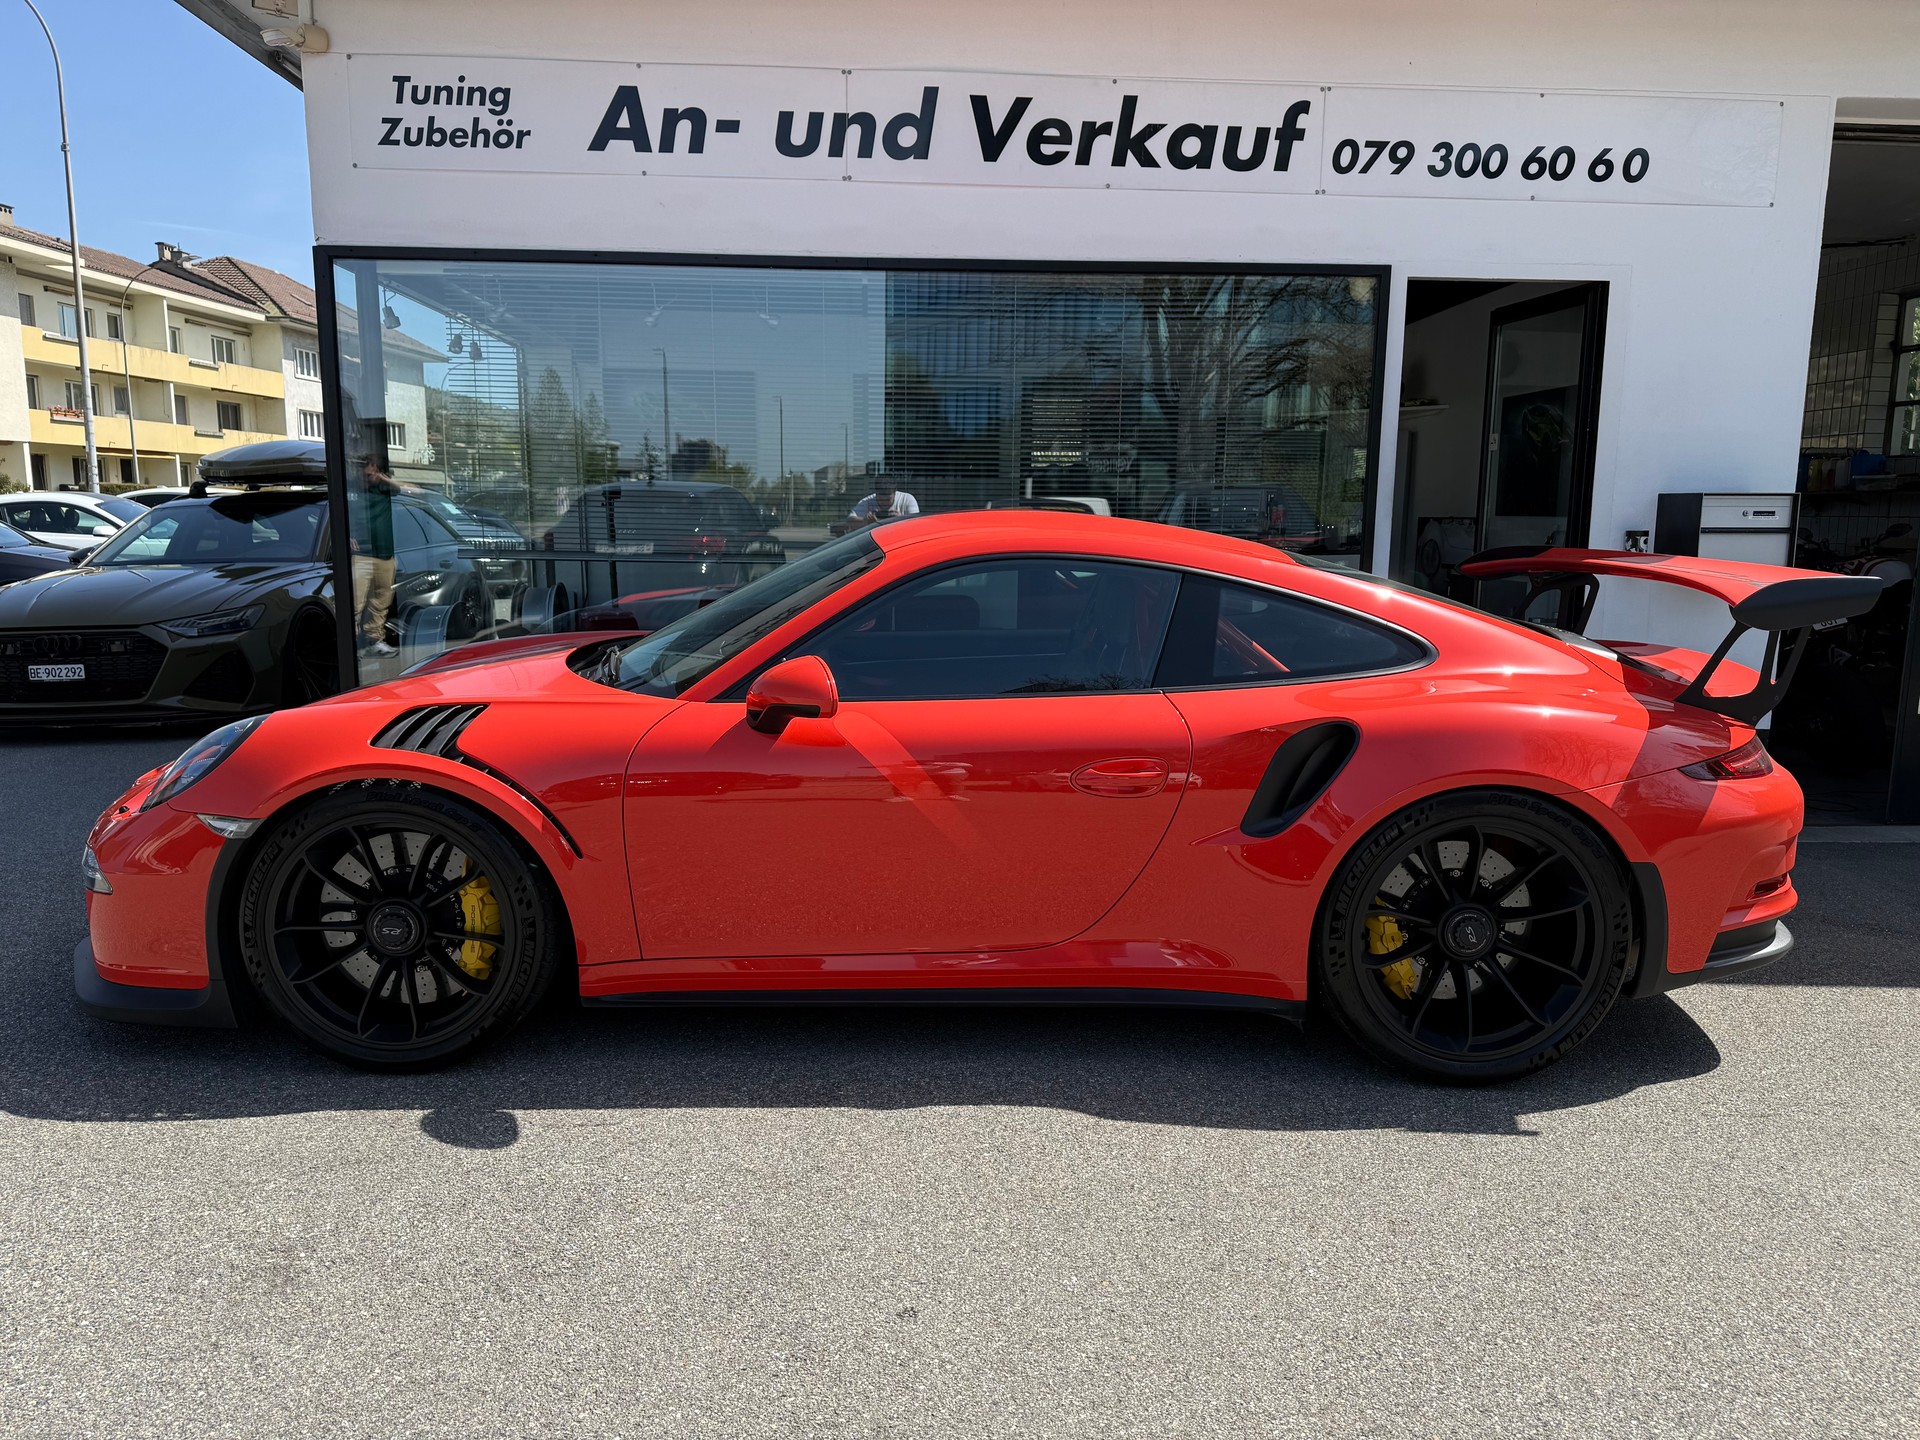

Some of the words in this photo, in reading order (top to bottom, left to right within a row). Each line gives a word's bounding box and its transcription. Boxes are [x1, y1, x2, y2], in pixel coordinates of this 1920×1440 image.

[392, 74, 511, 117] Tuning
[377, 116, 532, 149] Zubehör
[587, 85, 741, 154] An-
[775, 85, 940, 161] und
[969, 94, 1311, 172] Verkauf
[1332, 138, 1416, 175] 079
[1427, 141, 1509, 180] 300
[1520, 145, 1576, 182] 60
[64, 666, 84, 678] 292
[243, 841, 282, 927] MICHELIN
[1335, 822, 1402, 916] MICHELIN
[1558, 965, 1623, 1055] MICHELIN
